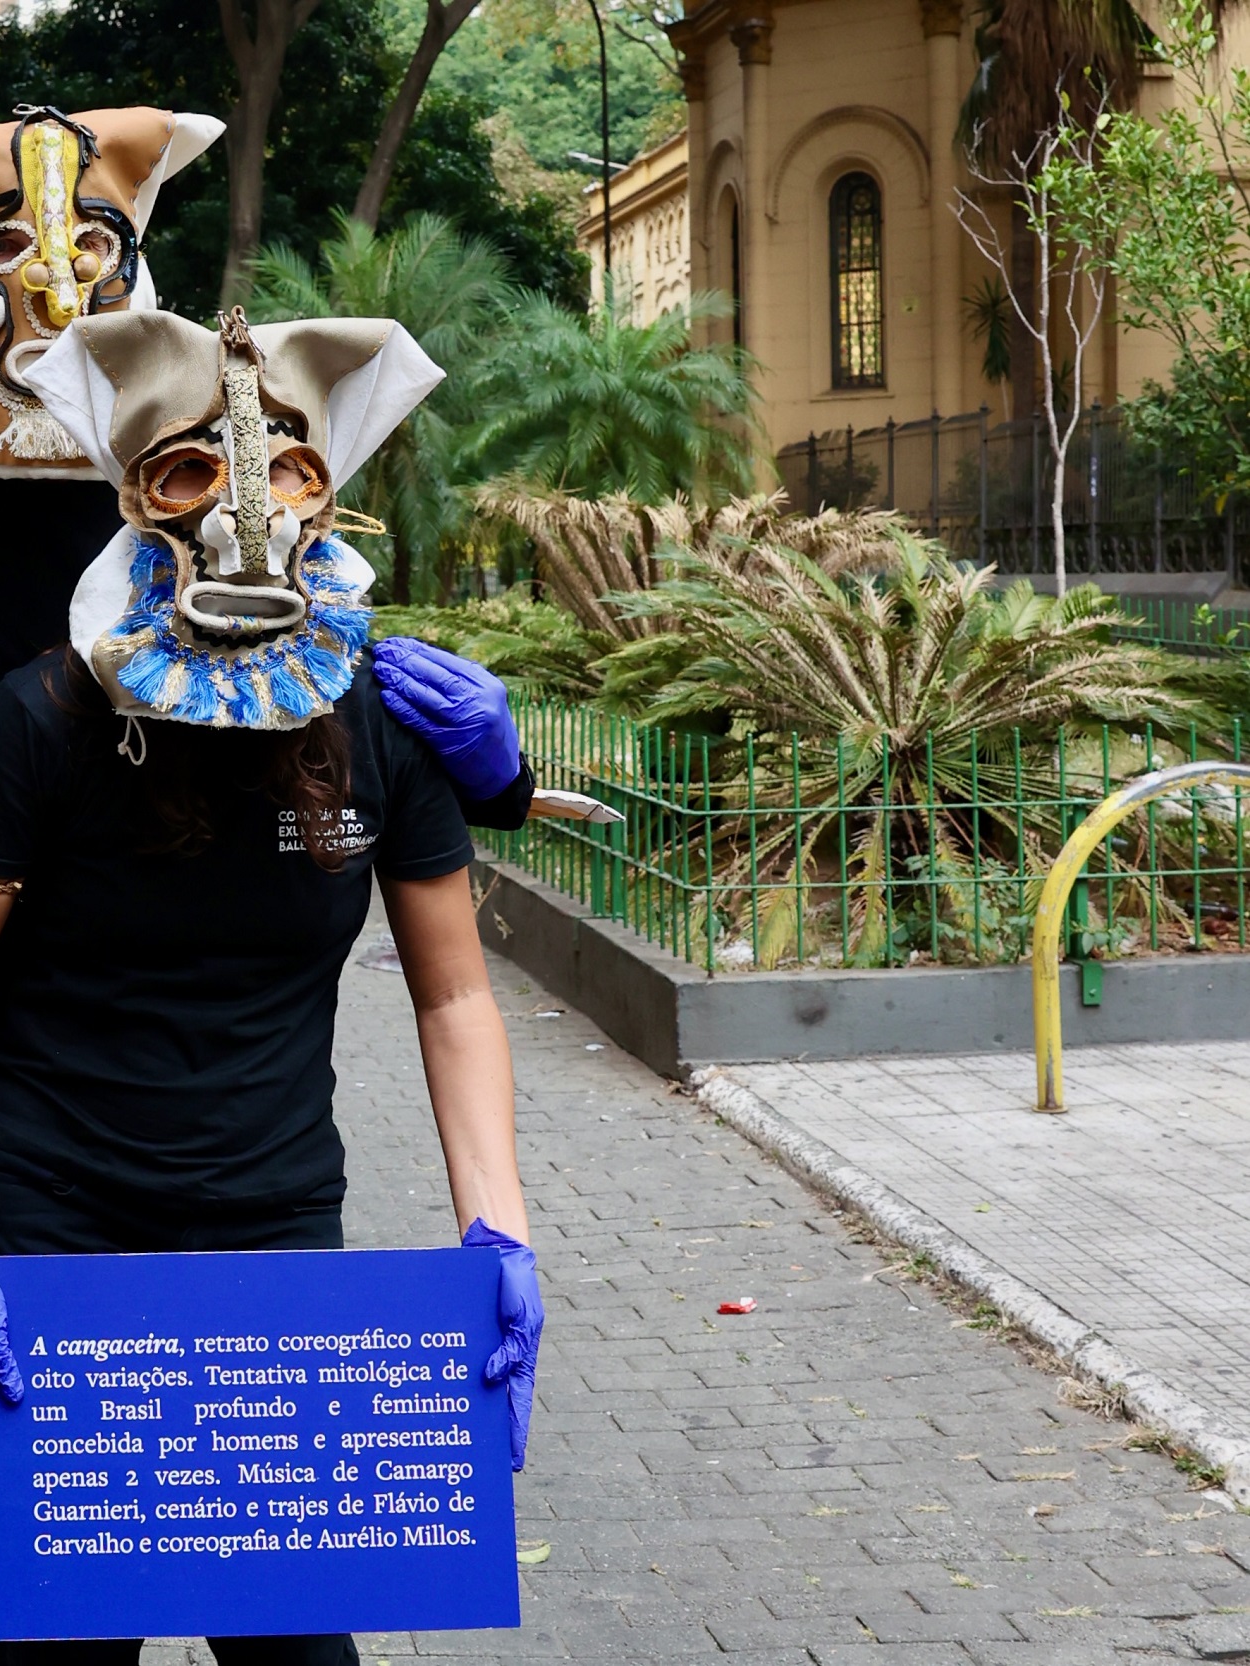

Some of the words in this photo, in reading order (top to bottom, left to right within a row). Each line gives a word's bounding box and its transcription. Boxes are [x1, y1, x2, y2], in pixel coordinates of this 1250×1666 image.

[341, 809, 357, 821] DE
[347, 823, 364, 835] DO
[28, 1335, 49, 1356] A
[56, 1333, 186, 1362] cangaceira,
[193, 1334, 270, 1354] retrato
[277, 1327, 412, 1357] coreográfico
[420, 1331, 467, 1349] com
[31, 1368, 76, 1389] oito
[84, 1366, 194, 1395] variações.
[203, 1363, 309, 1386] Tentativa
[317, 1360, 433, 1389] mitológica
[441, 1358, 469, 1381] de
[31, 1405, 69, 1422] um
[99, 1397, 163, 1421] Brasil
[193, 1395, 297, 1426] profundo
[327, 1400, 341, 1416] e
[371, 1392, 470, 1415] feminino
[32, 1431, 145, 1455] concebida
[157, 1436, 198, 1460] por
[210, 1429, 299, 1452] homens
[313, 1433, 326, 1450] e
[340, 1423, 473, 1455] apresentada
[32, 1471, 109, 1495] apenas
[125, 1470, 139, 1487] 2
[153, 1469, 221, 1486] vezes.
[237, 1461, 317, 1485] Música
[332, 1459, 359, 1482] de
[375, 1459, 474, 1486] Camargo
[33, 1498, 147, 1524] Guarnieri,
[155, 1496, 238, 1520] cenário
[245, 1501, 259, 1518] e
[267, 1497, 329, 1524] trajes
[337, 1492, 365, 1516] de
[372, 1491, 440, 1514] Flávio
[448, 1489, 475, 1512] de
[33, 1531, 134, 1556] Carvalho
[138, 1537, 152, 1554] e
[157, 1528, 282, 1559] coreografia
[285, 1527, 313, 1550] de
[316, 1525, 398, 1549] Aurélio
[402, 1523, 477, 1547] Millos.
